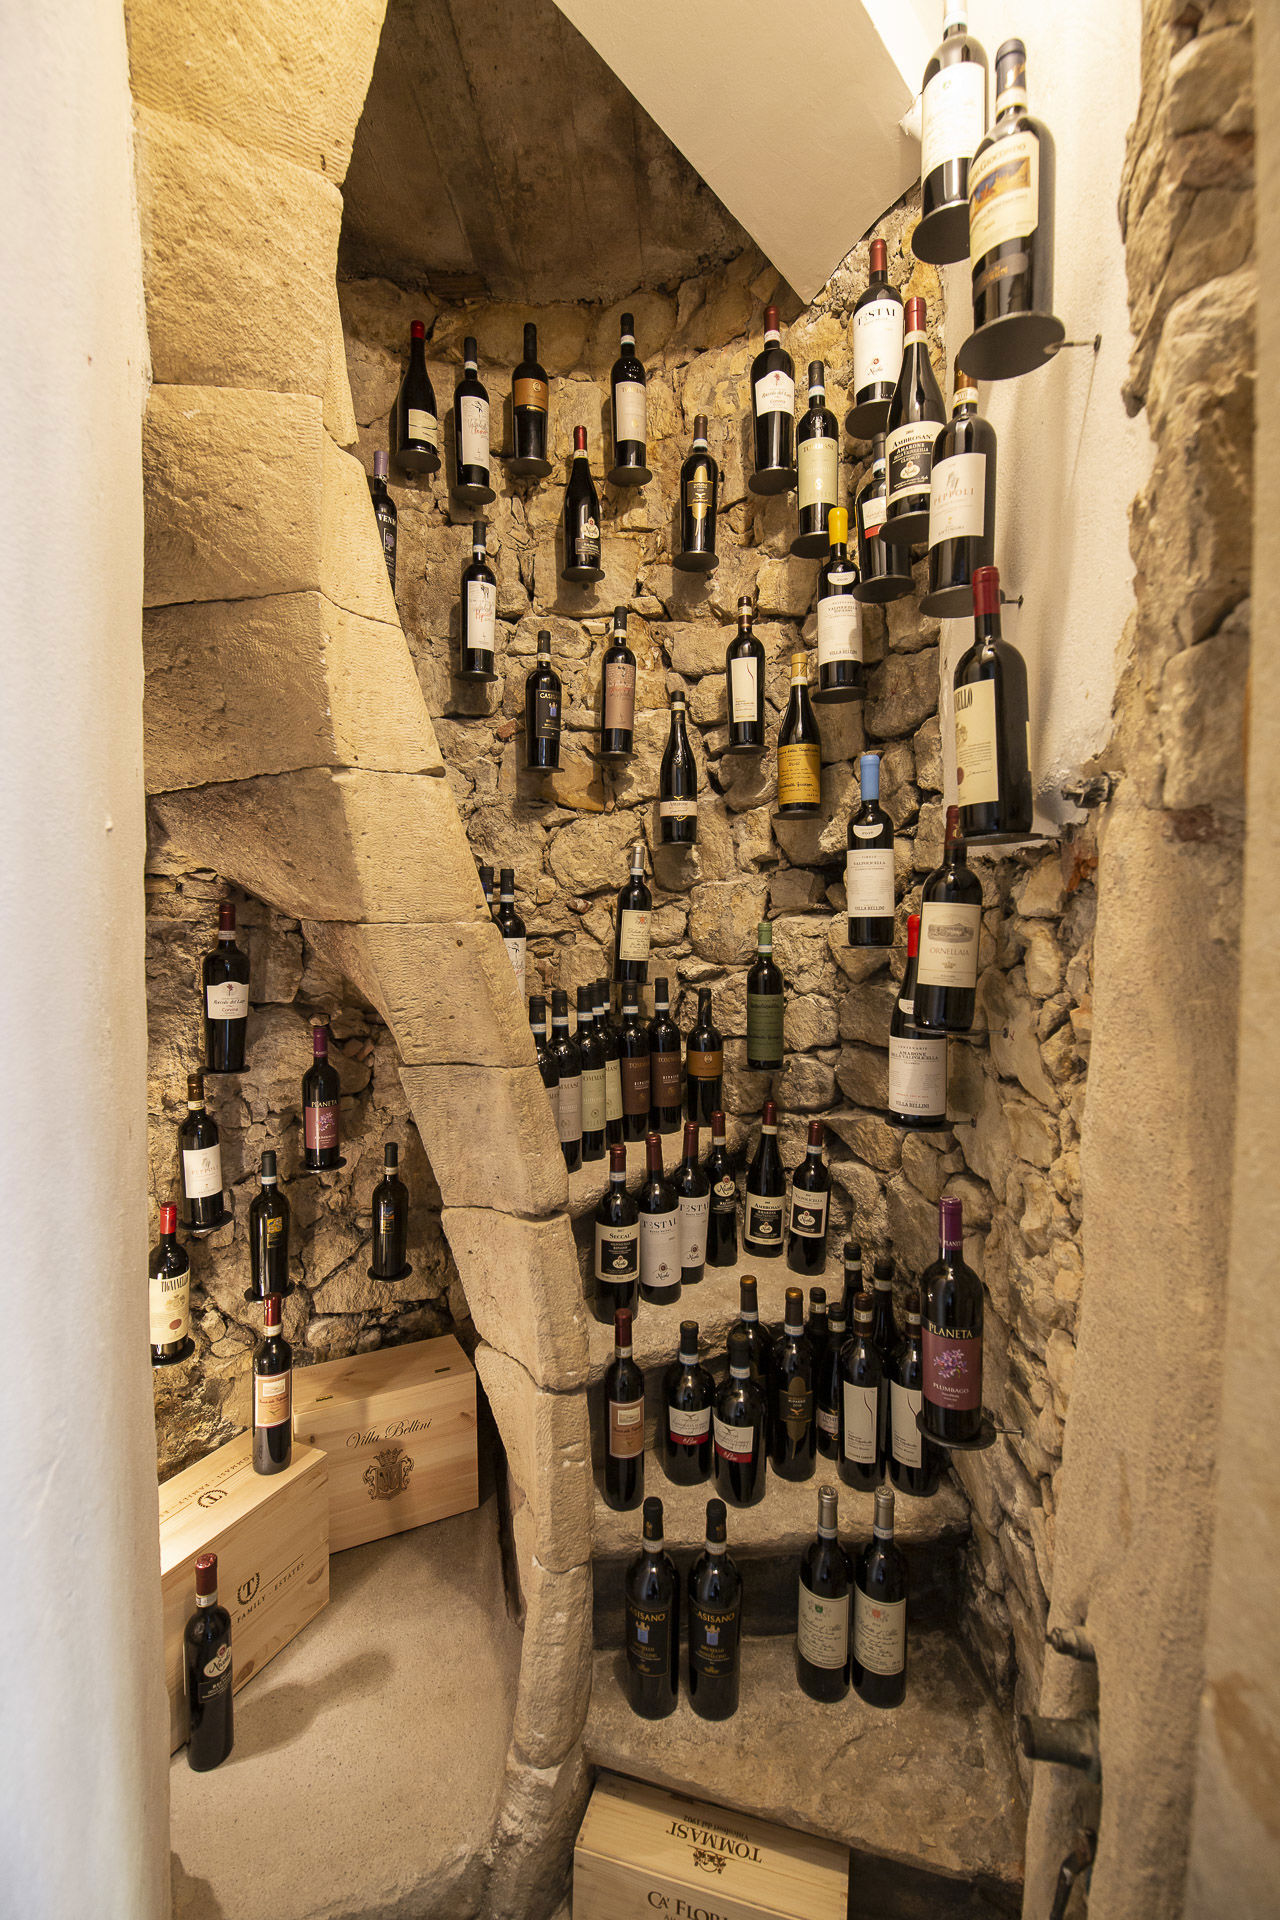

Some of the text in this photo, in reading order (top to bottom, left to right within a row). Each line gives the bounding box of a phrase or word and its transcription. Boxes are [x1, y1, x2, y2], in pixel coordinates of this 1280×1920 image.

[928, 1324, 973, 1339] PLANETA
[932, 1383, 970, 1394] PLUMBAGO
[346, 1417, 433, 1449] Villa Bellini
[236, 1562, 305, 1624] FAMILY ESTATES
[666, 1821, 763, 1863] TOMMASI
